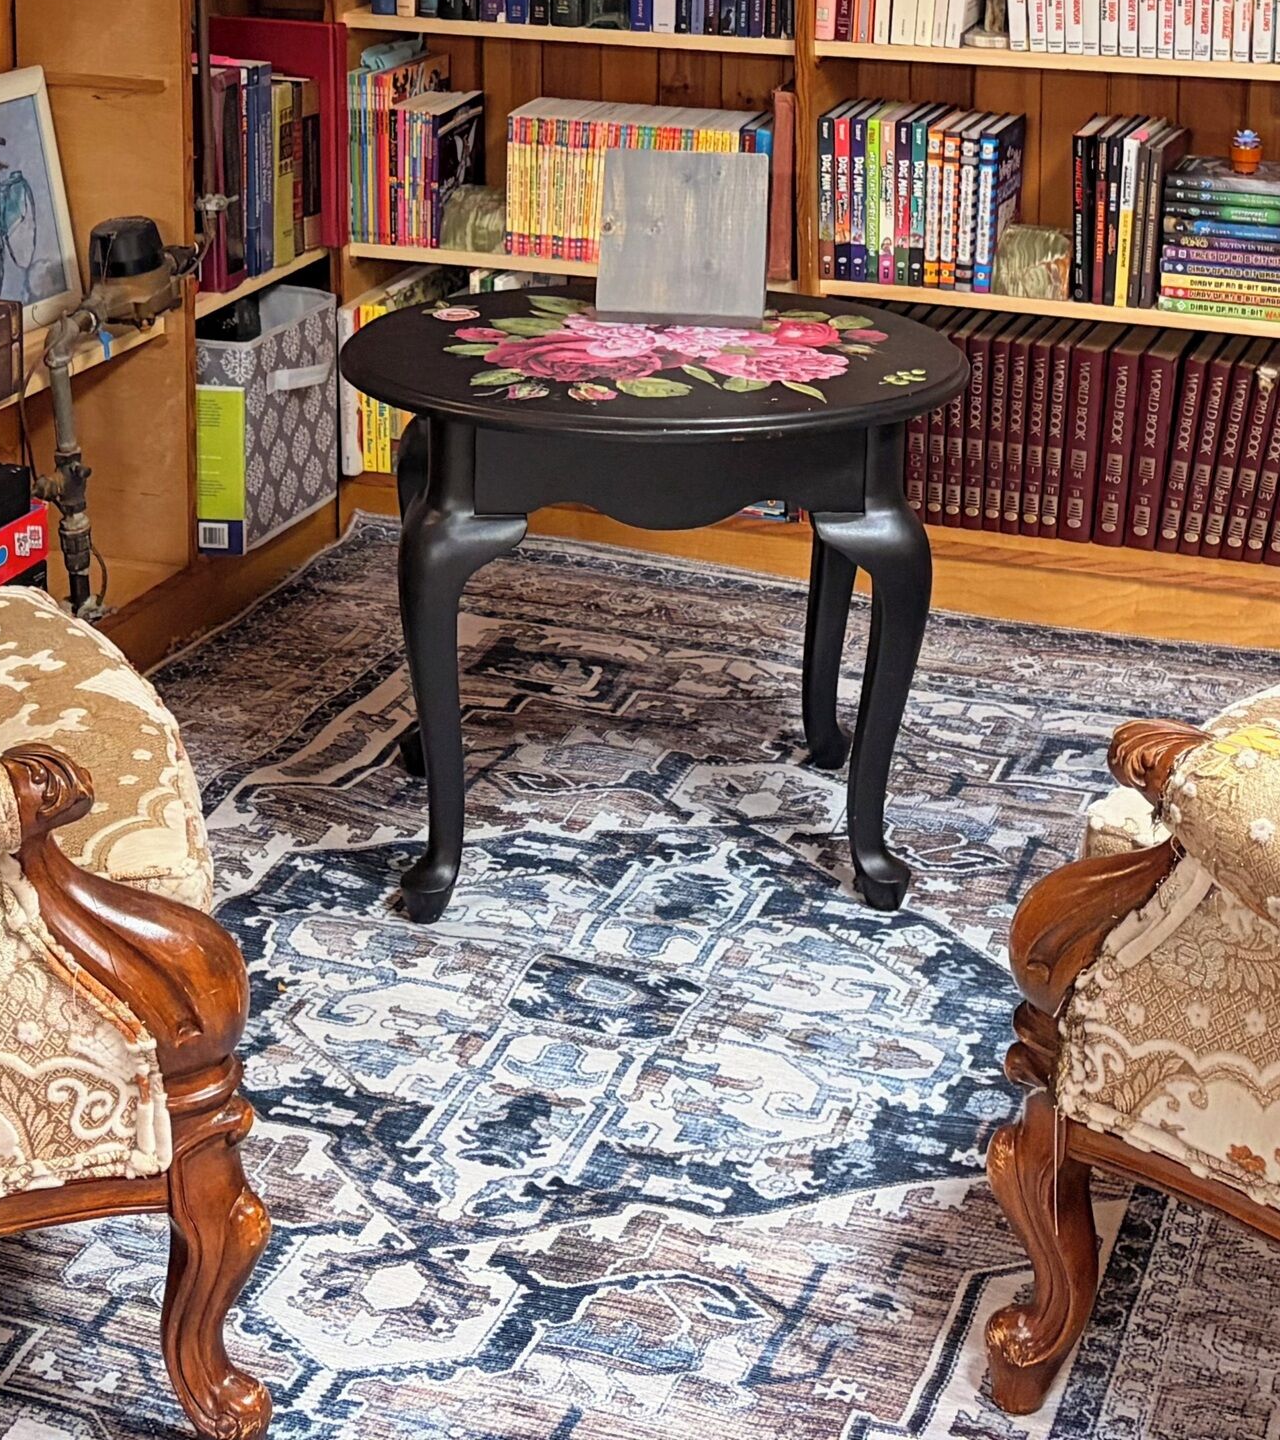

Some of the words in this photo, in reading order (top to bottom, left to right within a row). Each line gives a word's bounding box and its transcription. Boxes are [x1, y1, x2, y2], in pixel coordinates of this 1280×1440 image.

[821, 154, 833, 173] DOG
[822, 173, 833, 191] MAN
[1075, 156, 1083, 211] MINECRAFT
[1190, 279, 1213, 288] DIARY
[1214, 281, 1224, 289] OF
[972, 351, 984, 395] WORLD
[1033, 357, 1046, 401] WORLD
[1147, 368, 1163, 413] WORLD
[969, 395, 983, 432] BOOK
[1029, 402, 1043, 437] BOOK
[1143, 413, 1159, 449] BOOK
